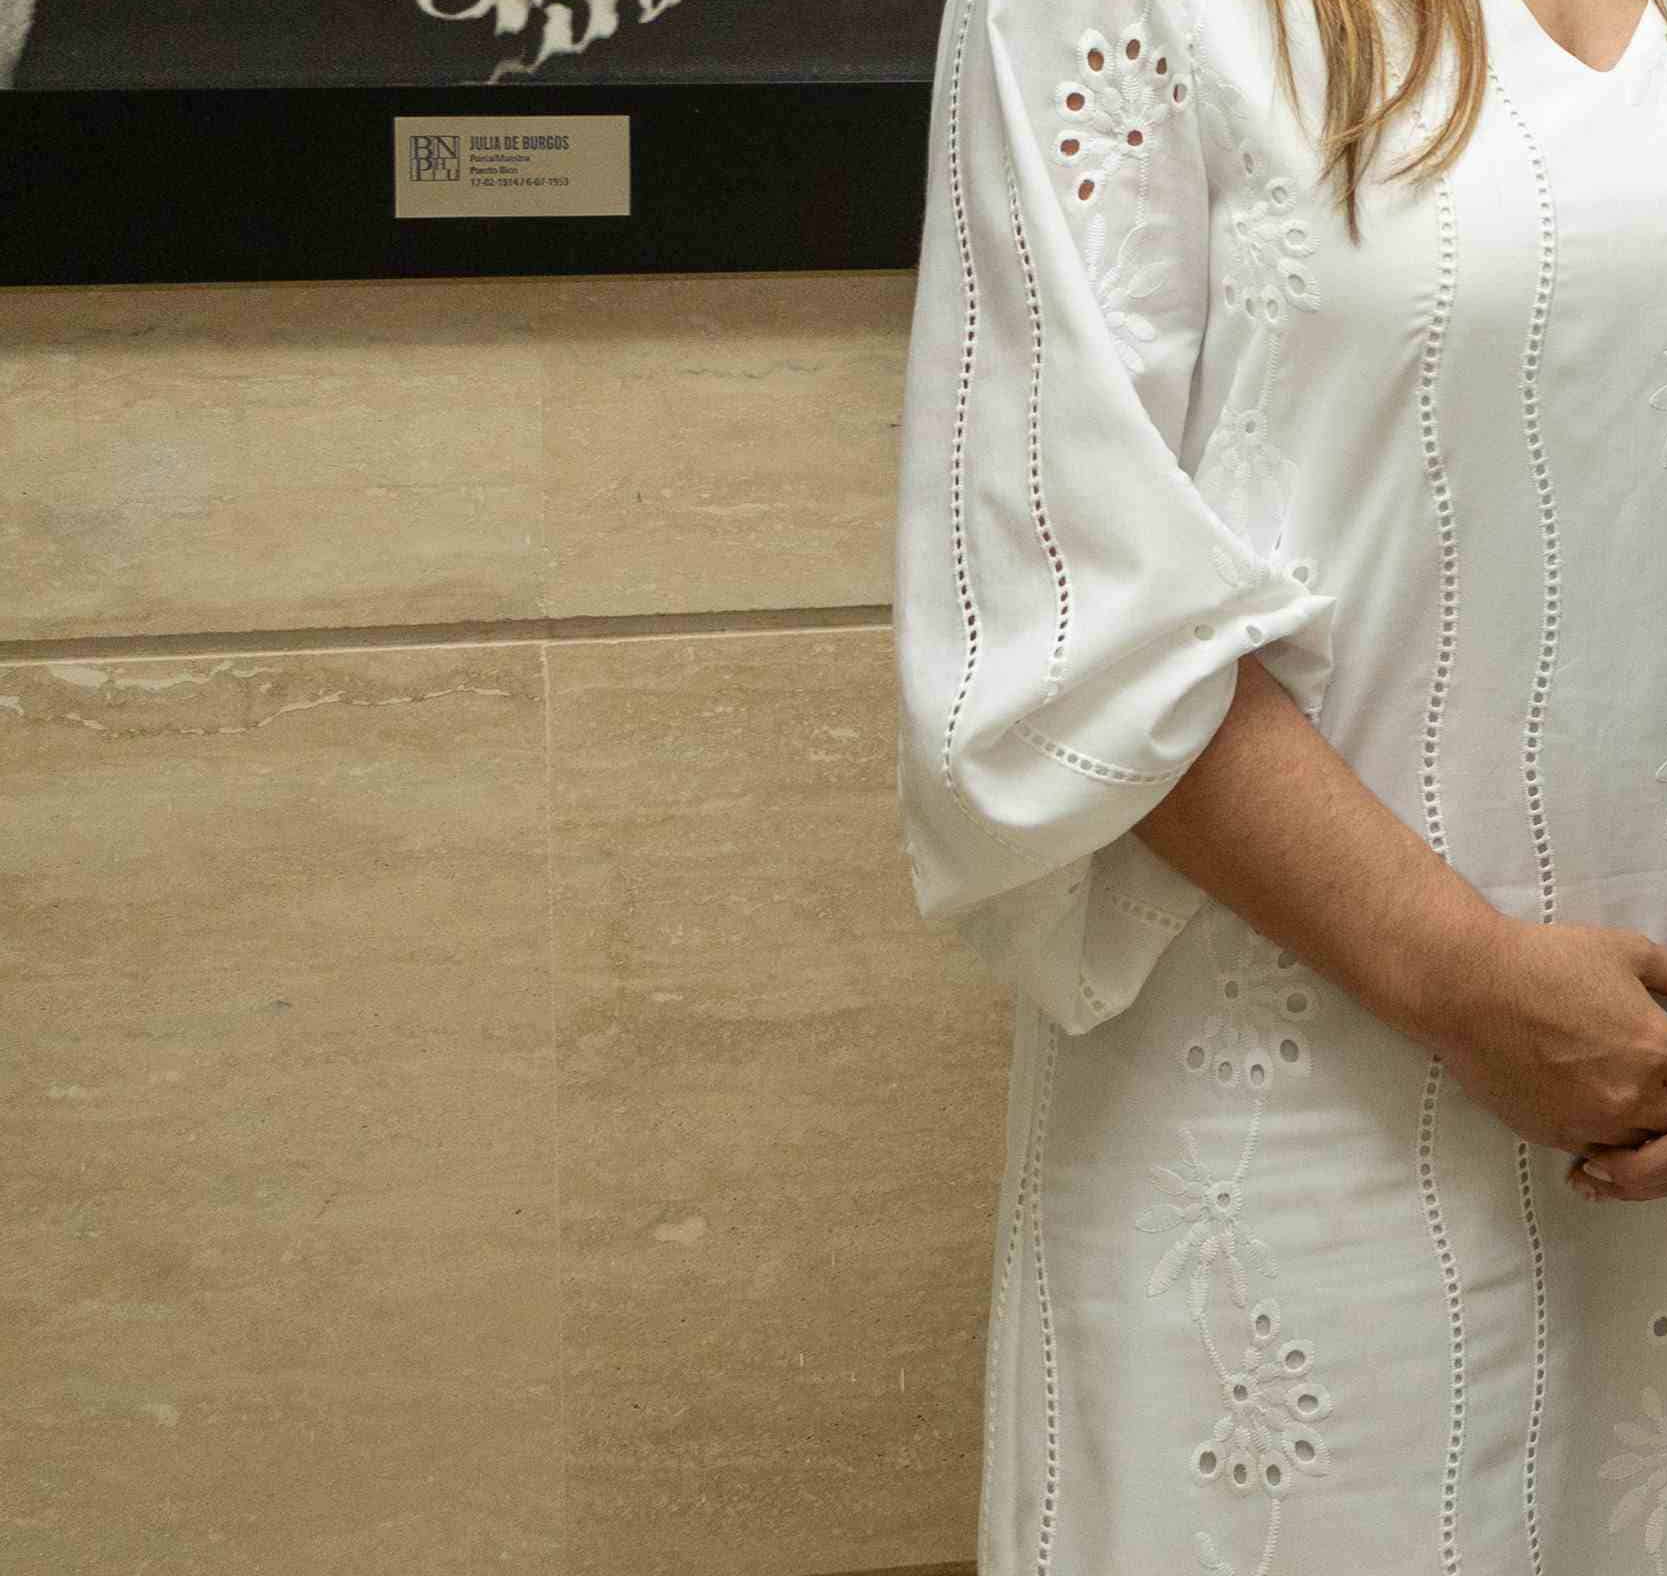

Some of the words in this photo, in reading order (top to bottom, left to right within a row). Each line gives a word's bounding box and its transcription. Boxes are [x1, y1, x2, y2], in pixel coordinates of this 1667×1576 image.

[470, 135, 501, 150] JULIA
[504, 135, 520, 150] DE
[522, 135, 570, 150] BURGOS
